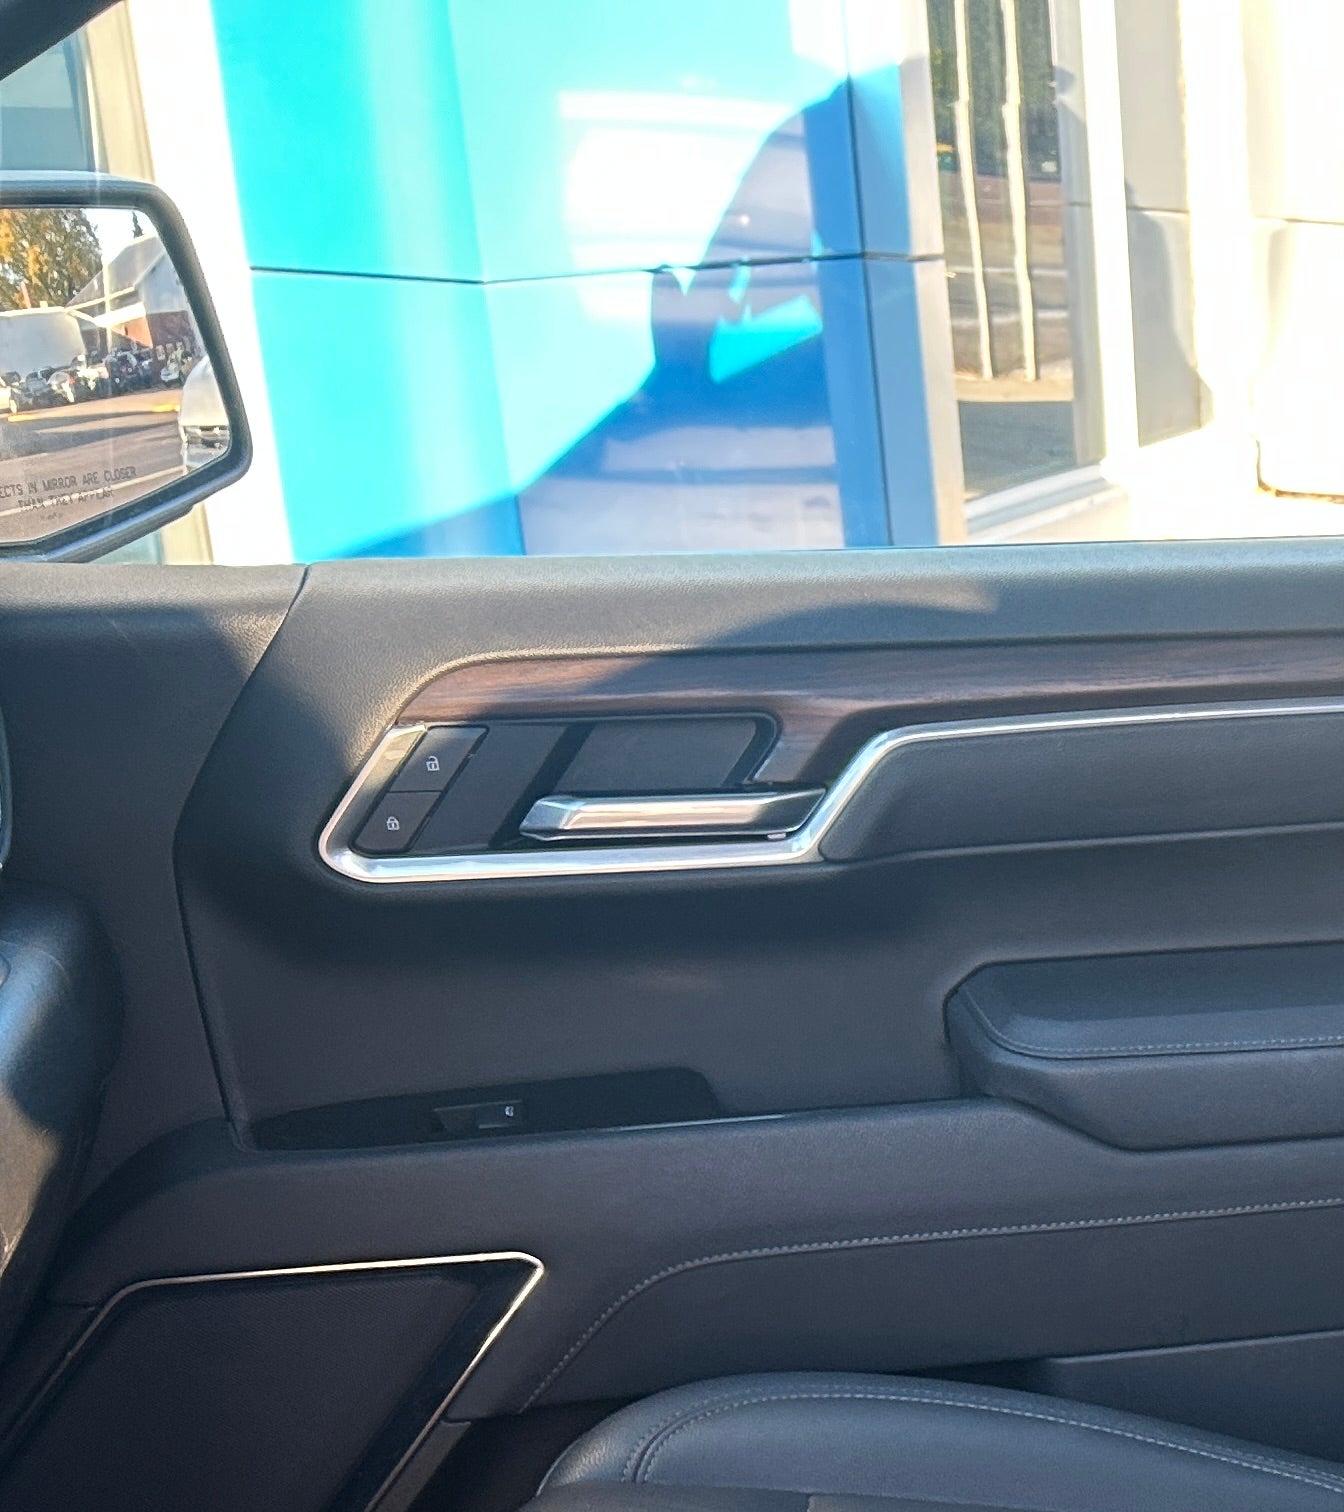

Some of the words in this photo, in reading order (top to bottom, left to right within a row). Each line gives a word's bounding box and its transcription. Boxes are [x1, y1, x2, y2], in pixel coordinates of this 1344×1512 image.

[29, 482, 38, 494] IN
[43, 476, 78, 491] MIRROR
[82, 472, 100, 485] ARE
[104, 466, 137, 482] CLOSER
